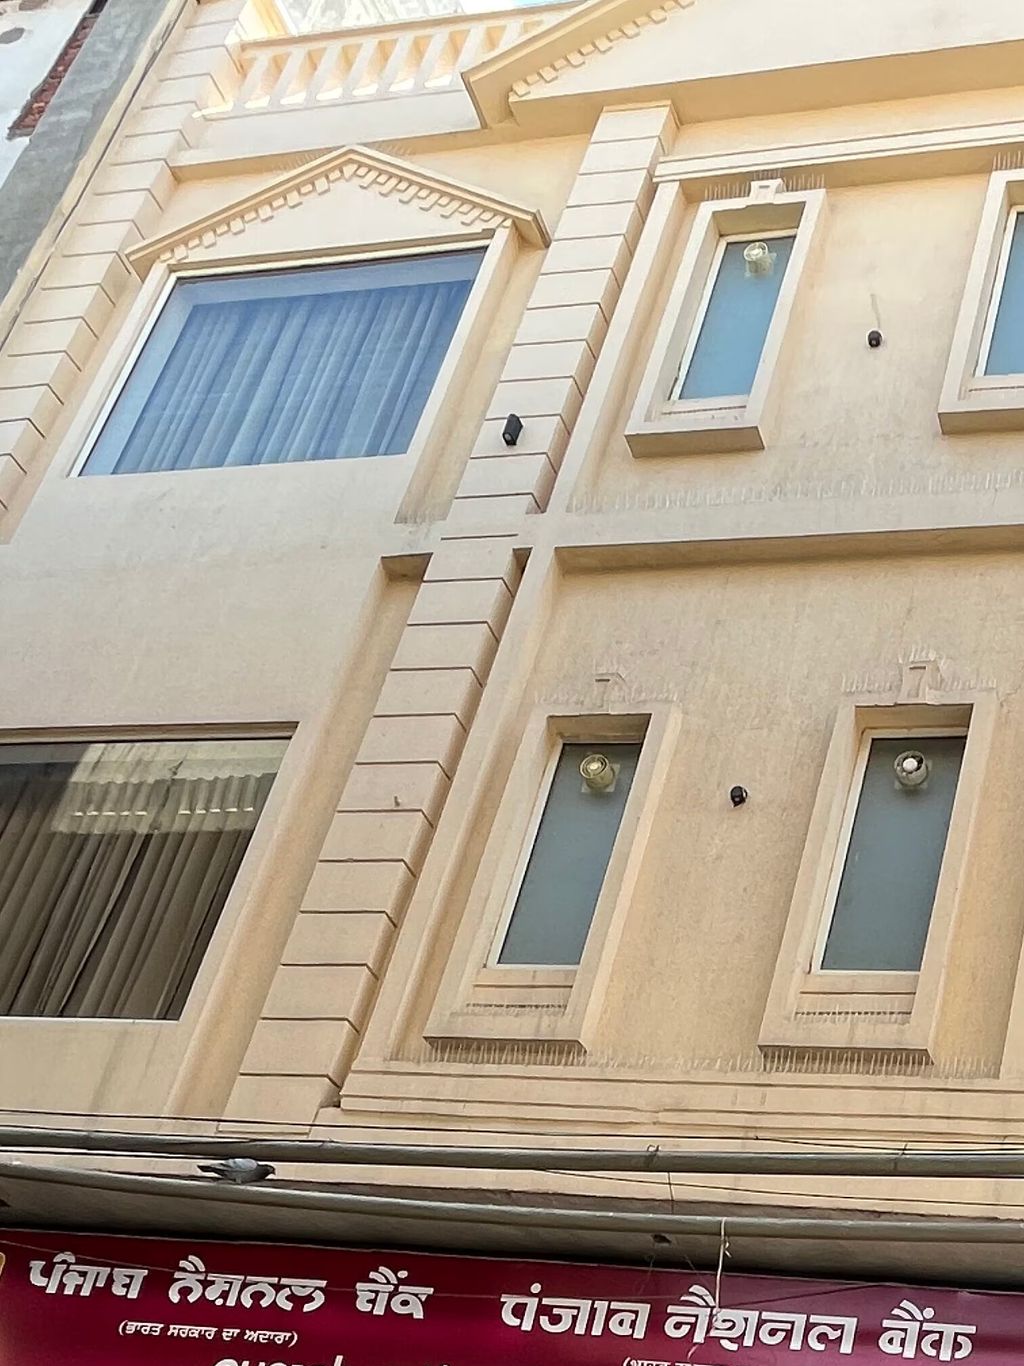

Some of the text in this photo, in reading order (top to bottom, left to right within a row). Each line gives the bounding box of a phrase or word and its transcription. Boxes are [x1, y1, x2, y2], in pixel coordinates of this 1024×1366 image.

[29, 1251, 434, 1319] ਪੰਜਾਬ ਨੈਸ਼ਨਲ ਬੈਂਕ
[500, 1282, 977, 1362] पंजाब नैशनल बैंक
